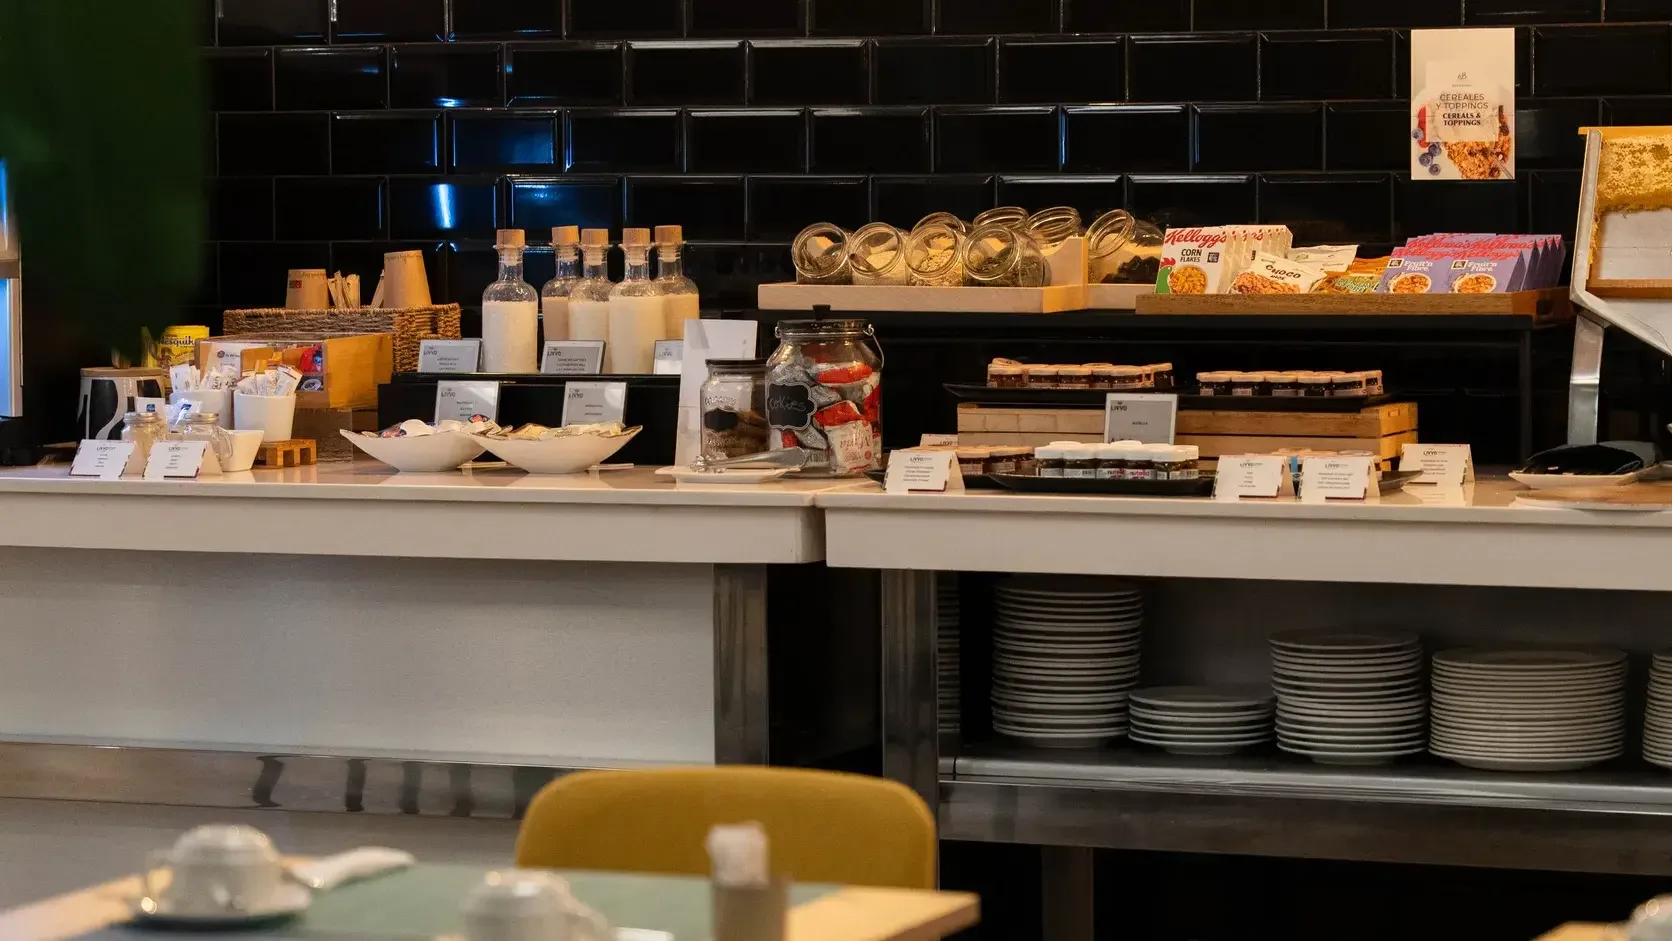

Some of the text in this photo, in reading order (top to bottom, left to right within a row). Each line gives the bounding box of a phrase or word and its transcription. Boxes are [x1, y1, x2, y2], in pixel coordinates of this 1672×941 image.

[1440, 93, 1485, 101] CEREALES
[1164, 229, 1227, 248] Kellogg's
[1181, 249, 1202, 257] CORN
[1265, 264, 1301, 279] CHOCO
